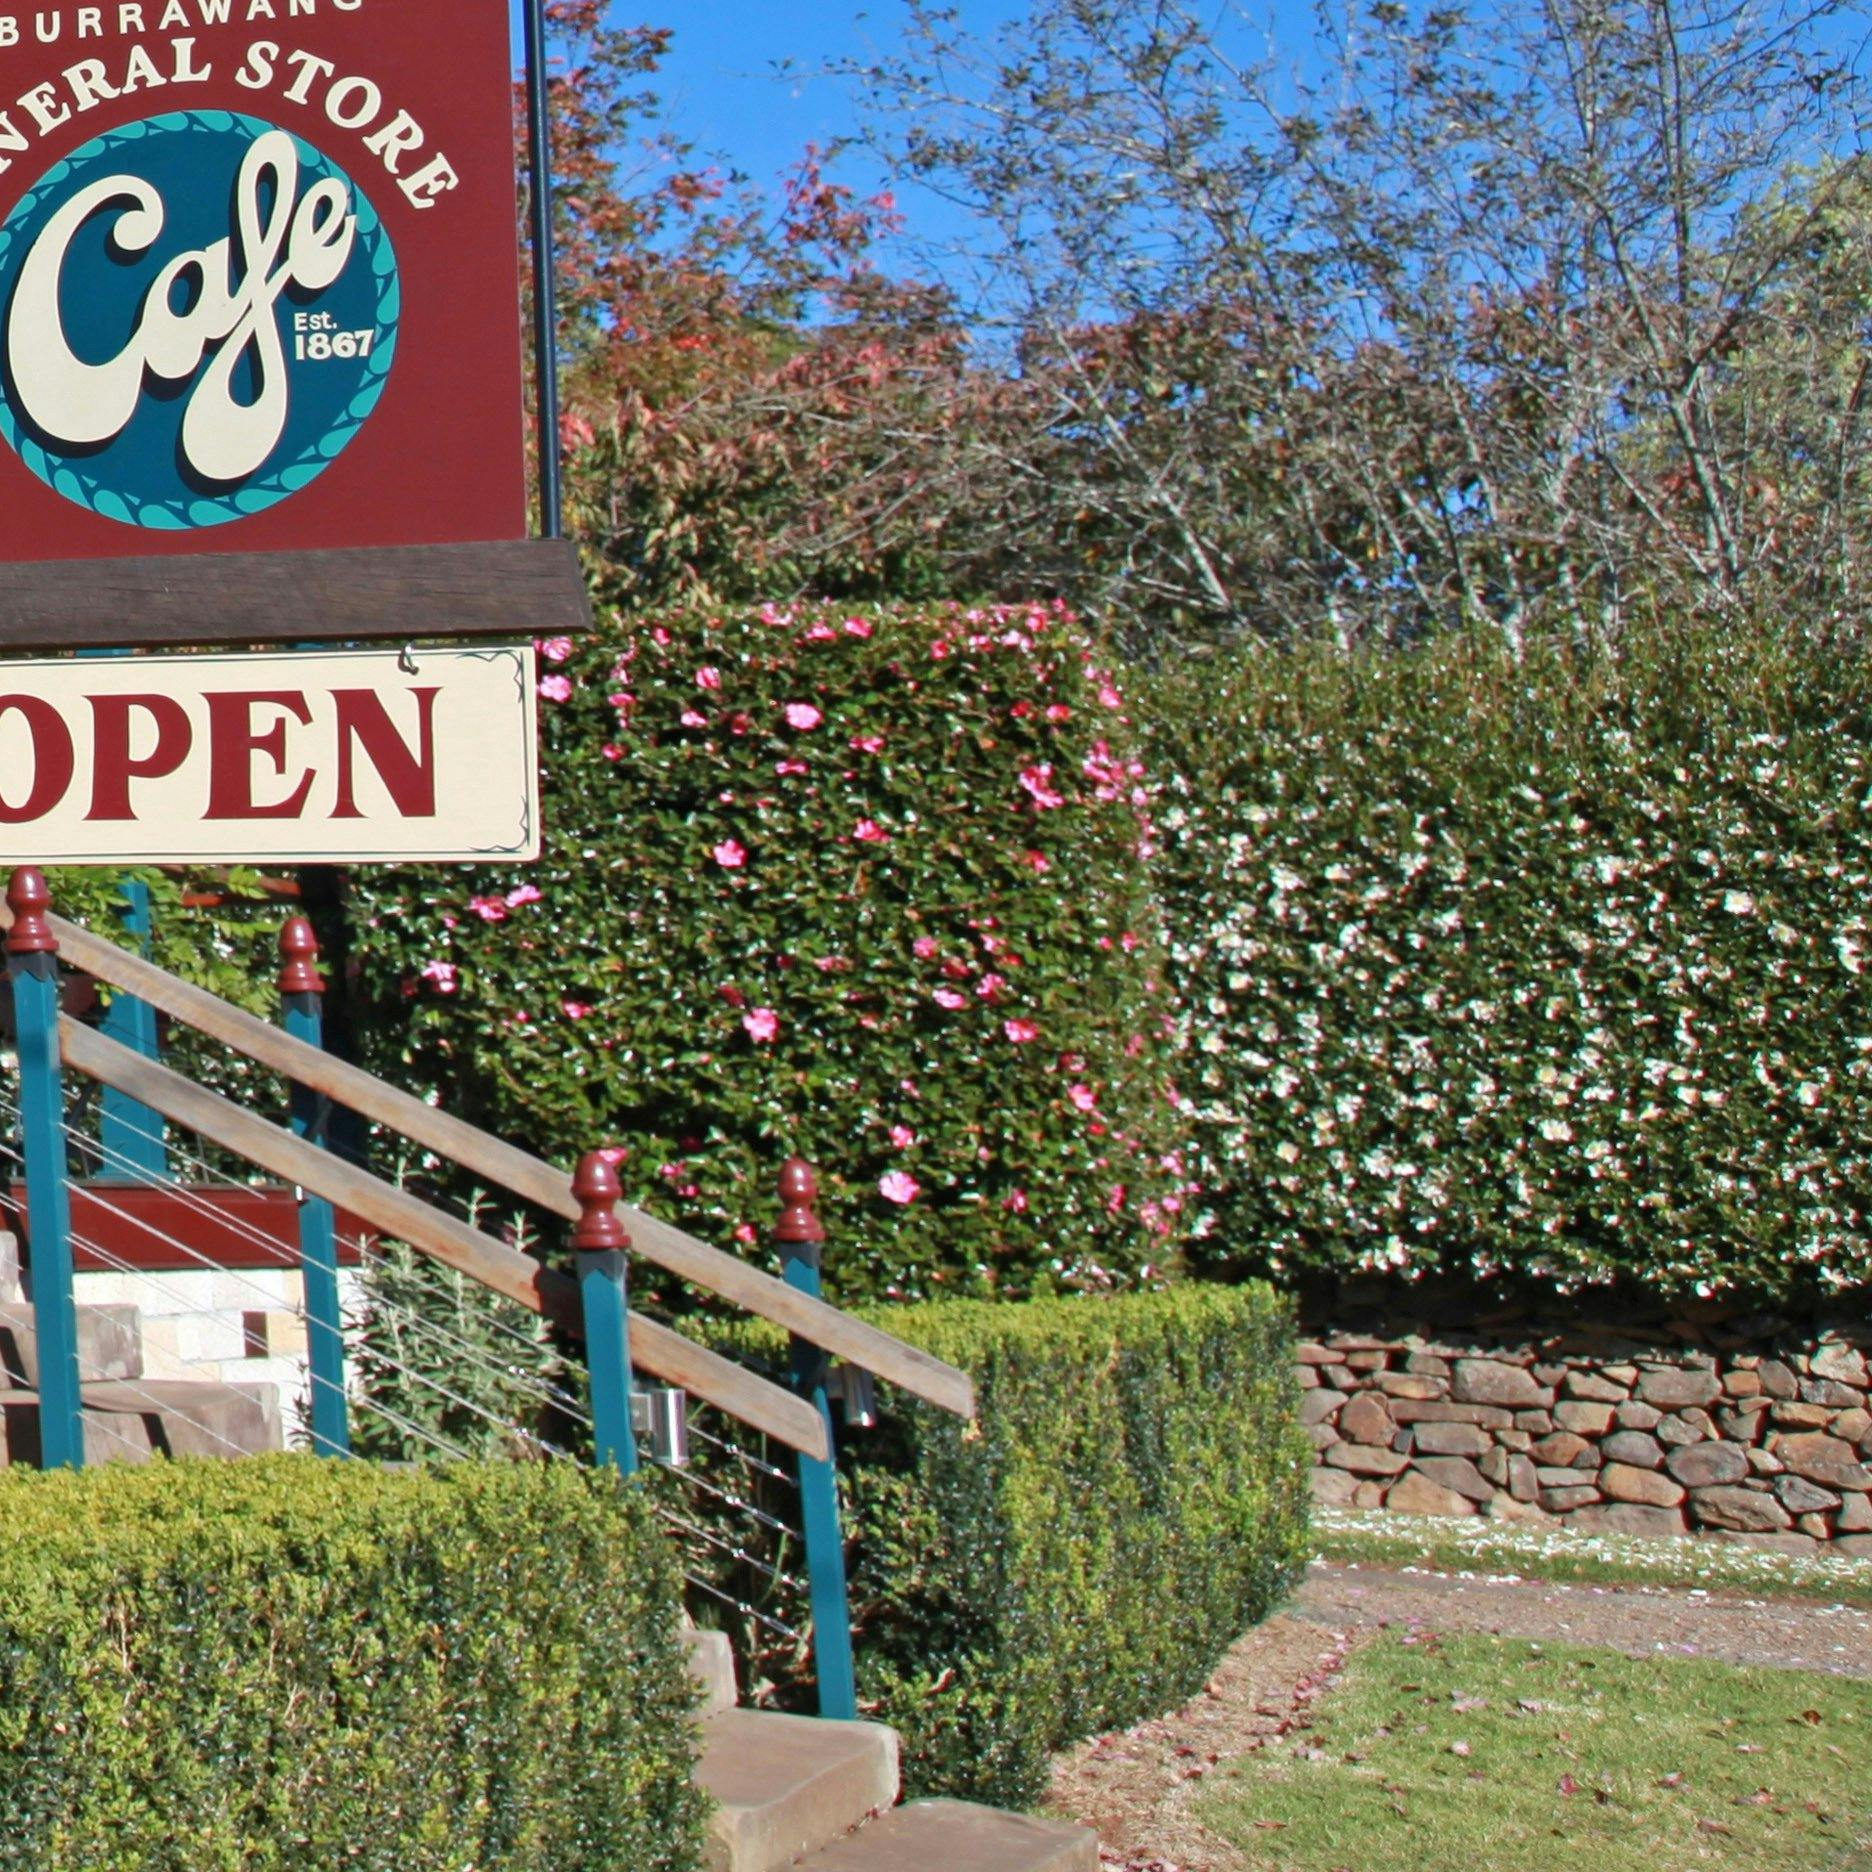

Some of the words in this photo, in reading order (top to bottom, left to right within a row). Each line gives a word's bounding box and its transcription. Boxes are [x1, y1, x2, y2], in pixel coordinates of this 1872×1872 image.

[235, 40, 460, 211] STORE
[9, 130, 357, 481] Cafe
[294, 311, 337, 331] Est.
[295, 329, 374, 360] 1867
